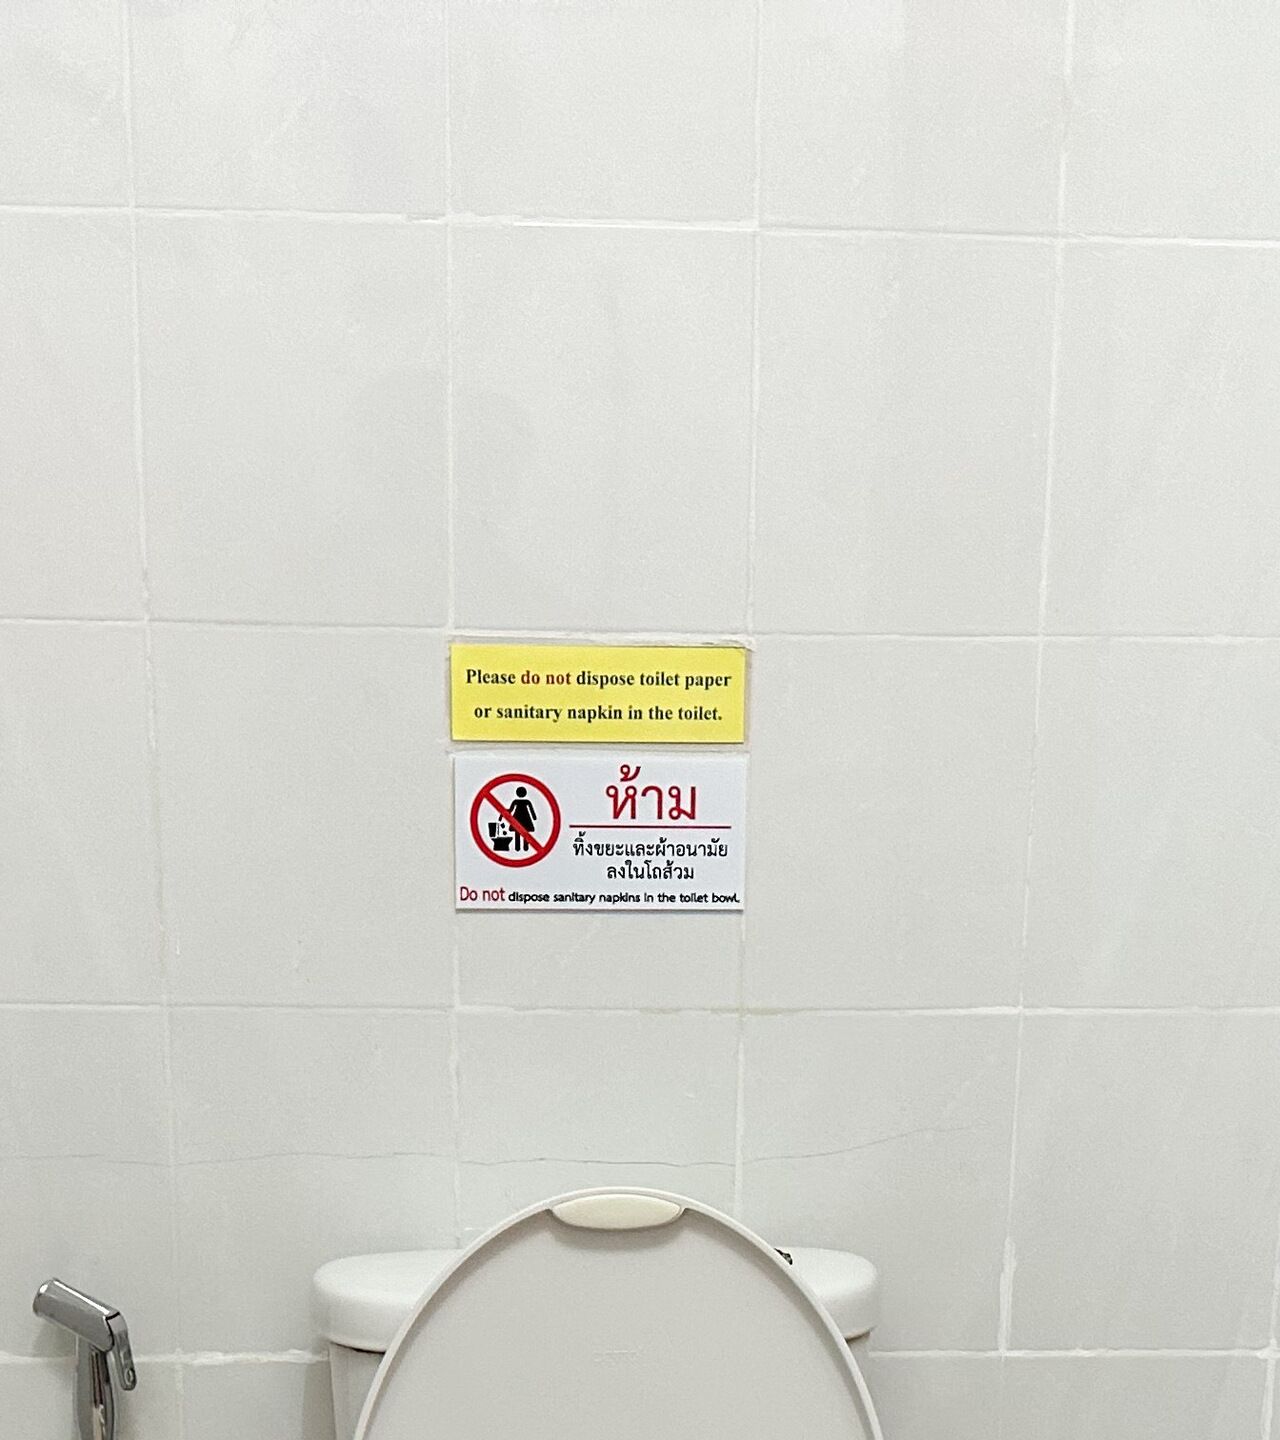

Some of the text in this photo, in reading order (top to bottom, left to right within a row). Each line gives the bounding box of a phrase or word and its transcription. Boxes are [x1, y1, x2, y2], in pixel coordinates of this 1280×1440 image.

[466, 669, 732, 690] Please do not dispose toilet paper
[474, 704, 722, 723] or sanitary napkin in the toilet.
[606, 764, 696, 820] ห้าม
[573, 831, 728, 857] ทิ้งขยะและผ้าอนามัย
[607, 860, 694, 879] ลงในโถส้วม
[460, 886, 478, 901] Do
[482, 888, 506, 901] not
[508, 892, 550, 904] dispose
[553, 892, 596, 905] sanitary
[599, 892, 641, 905] napkins
[644, 892, 654, 903] in
[657, 893, 676, 903] the
[680, 893, 709, 904] toilet
